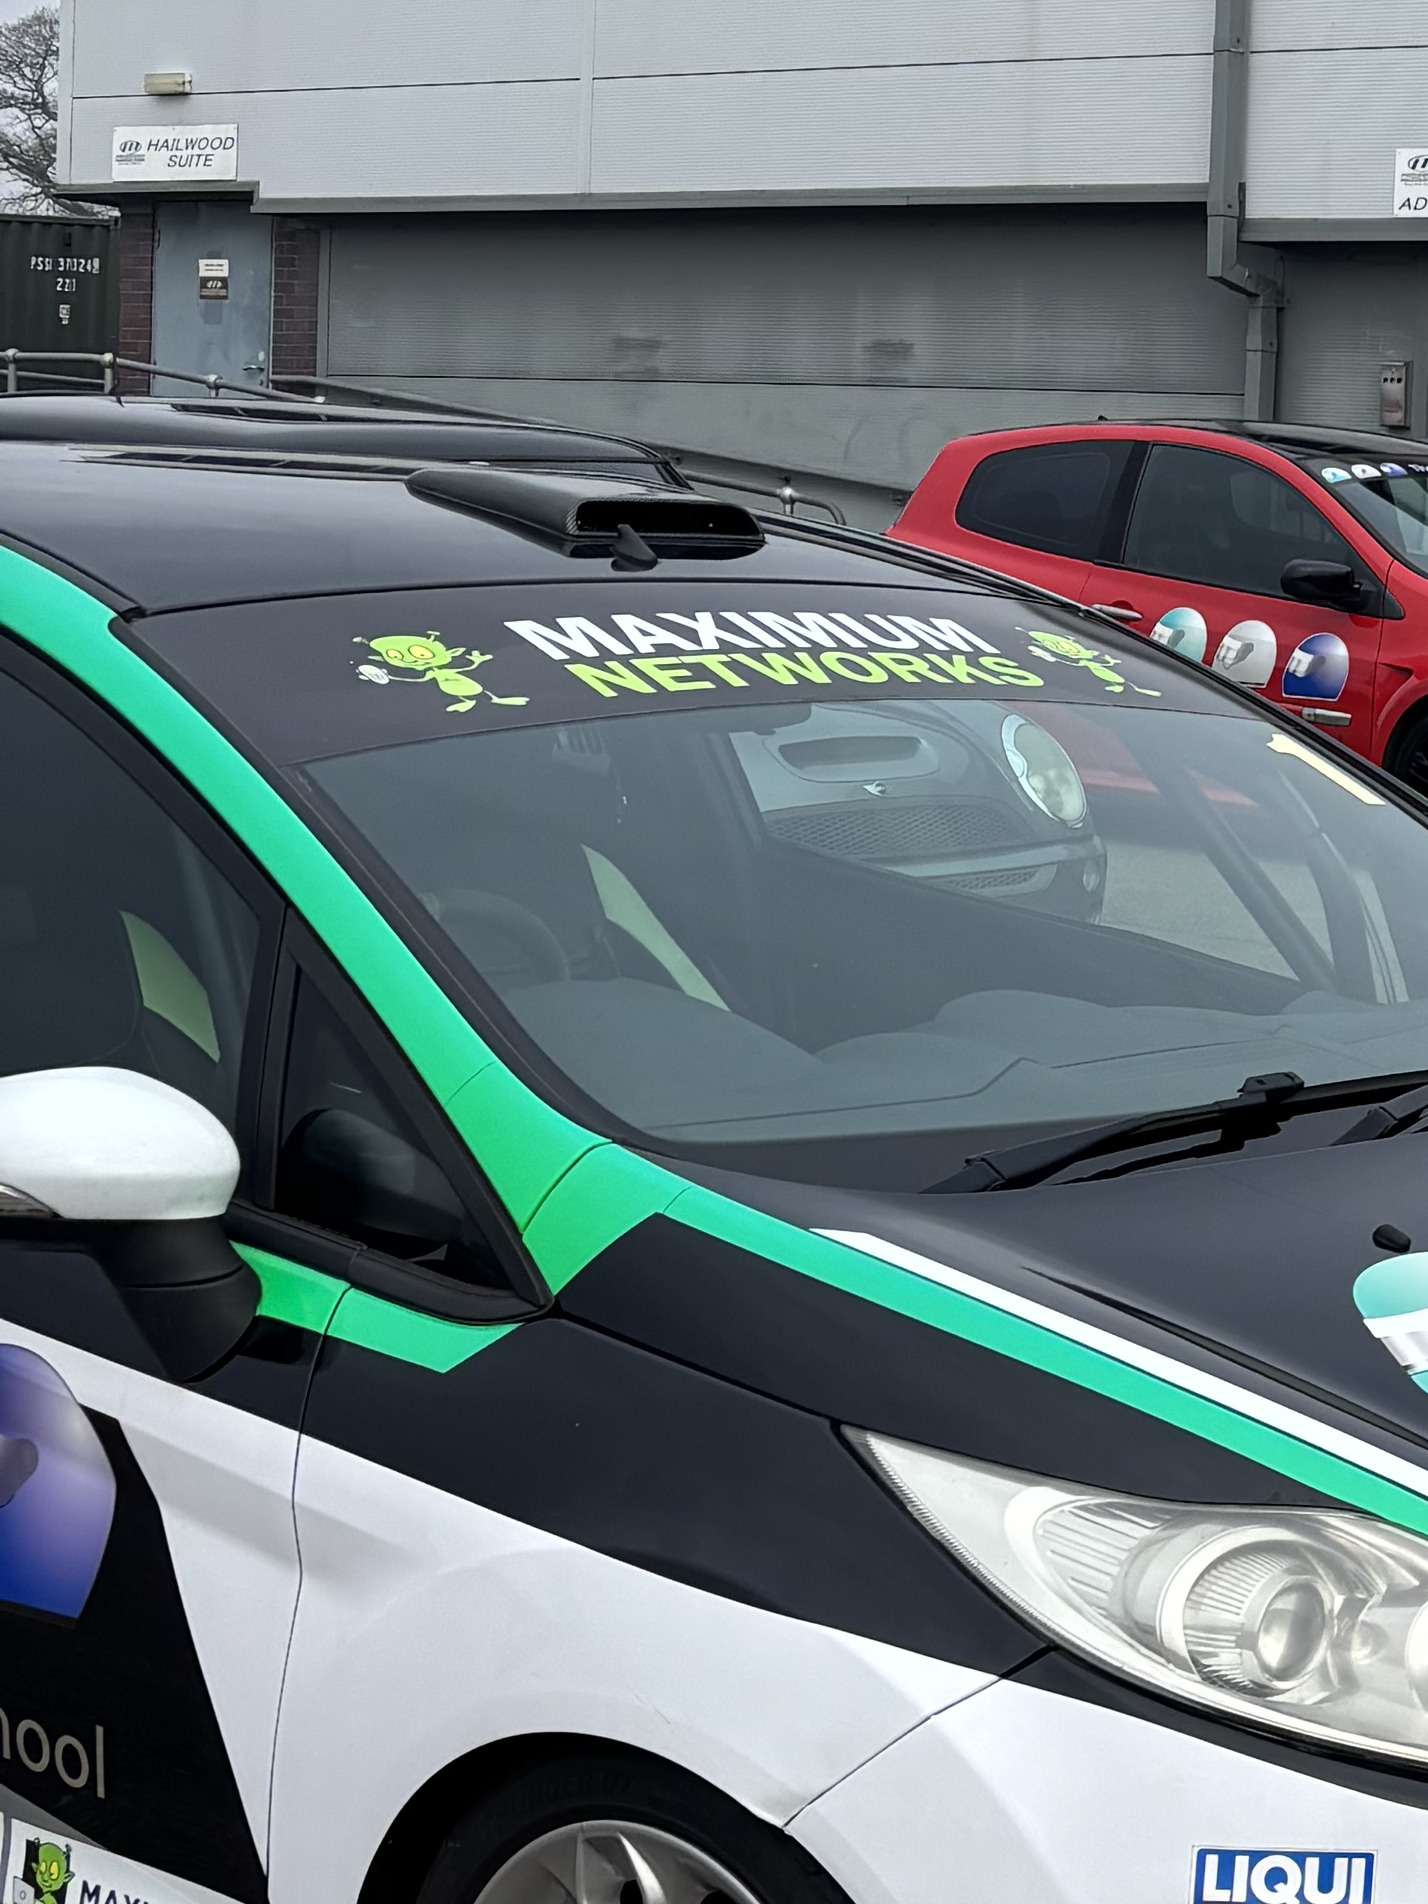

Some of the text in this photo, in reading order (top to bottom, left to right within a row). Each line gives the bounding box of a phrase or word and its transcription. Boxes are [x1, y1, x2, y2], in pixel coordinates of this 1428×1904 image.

[147, 137, 235, 152] HAILWOOD
[167, 153, 215, 168] SUITE
[503, 611, 1002, 661] MAXIMUM
[564, 649, 1045, 697] NETWORKS
